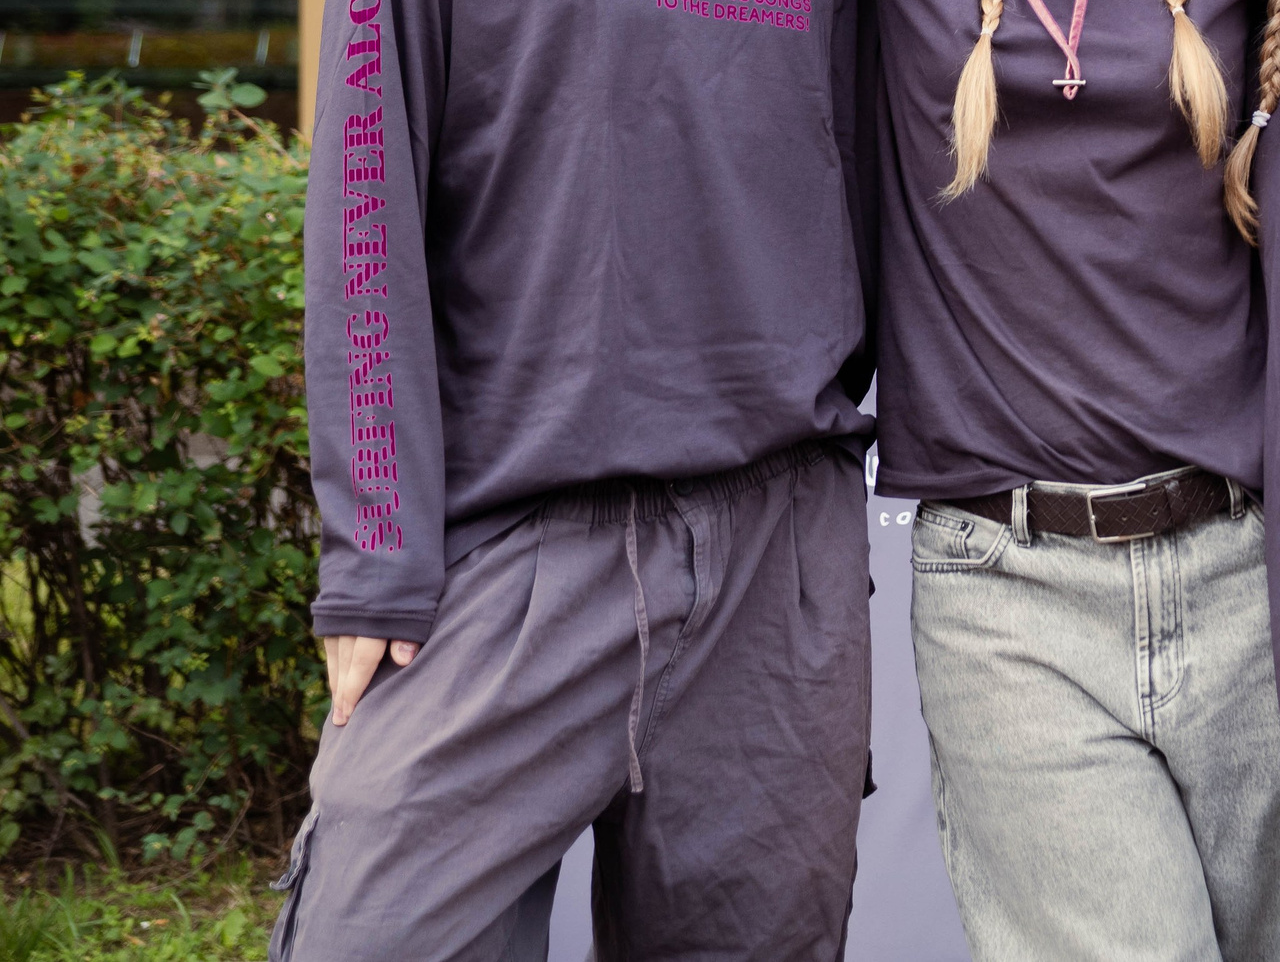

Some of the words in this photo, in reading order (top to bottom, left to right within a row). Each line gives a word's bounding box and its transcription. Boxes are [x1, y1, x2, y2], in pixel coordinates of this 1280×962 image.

[713, 3, 810, 32] DREAMERS!
[342, 105, 388, 300] NEVER
[345, 309, 403, 553] SURFING
